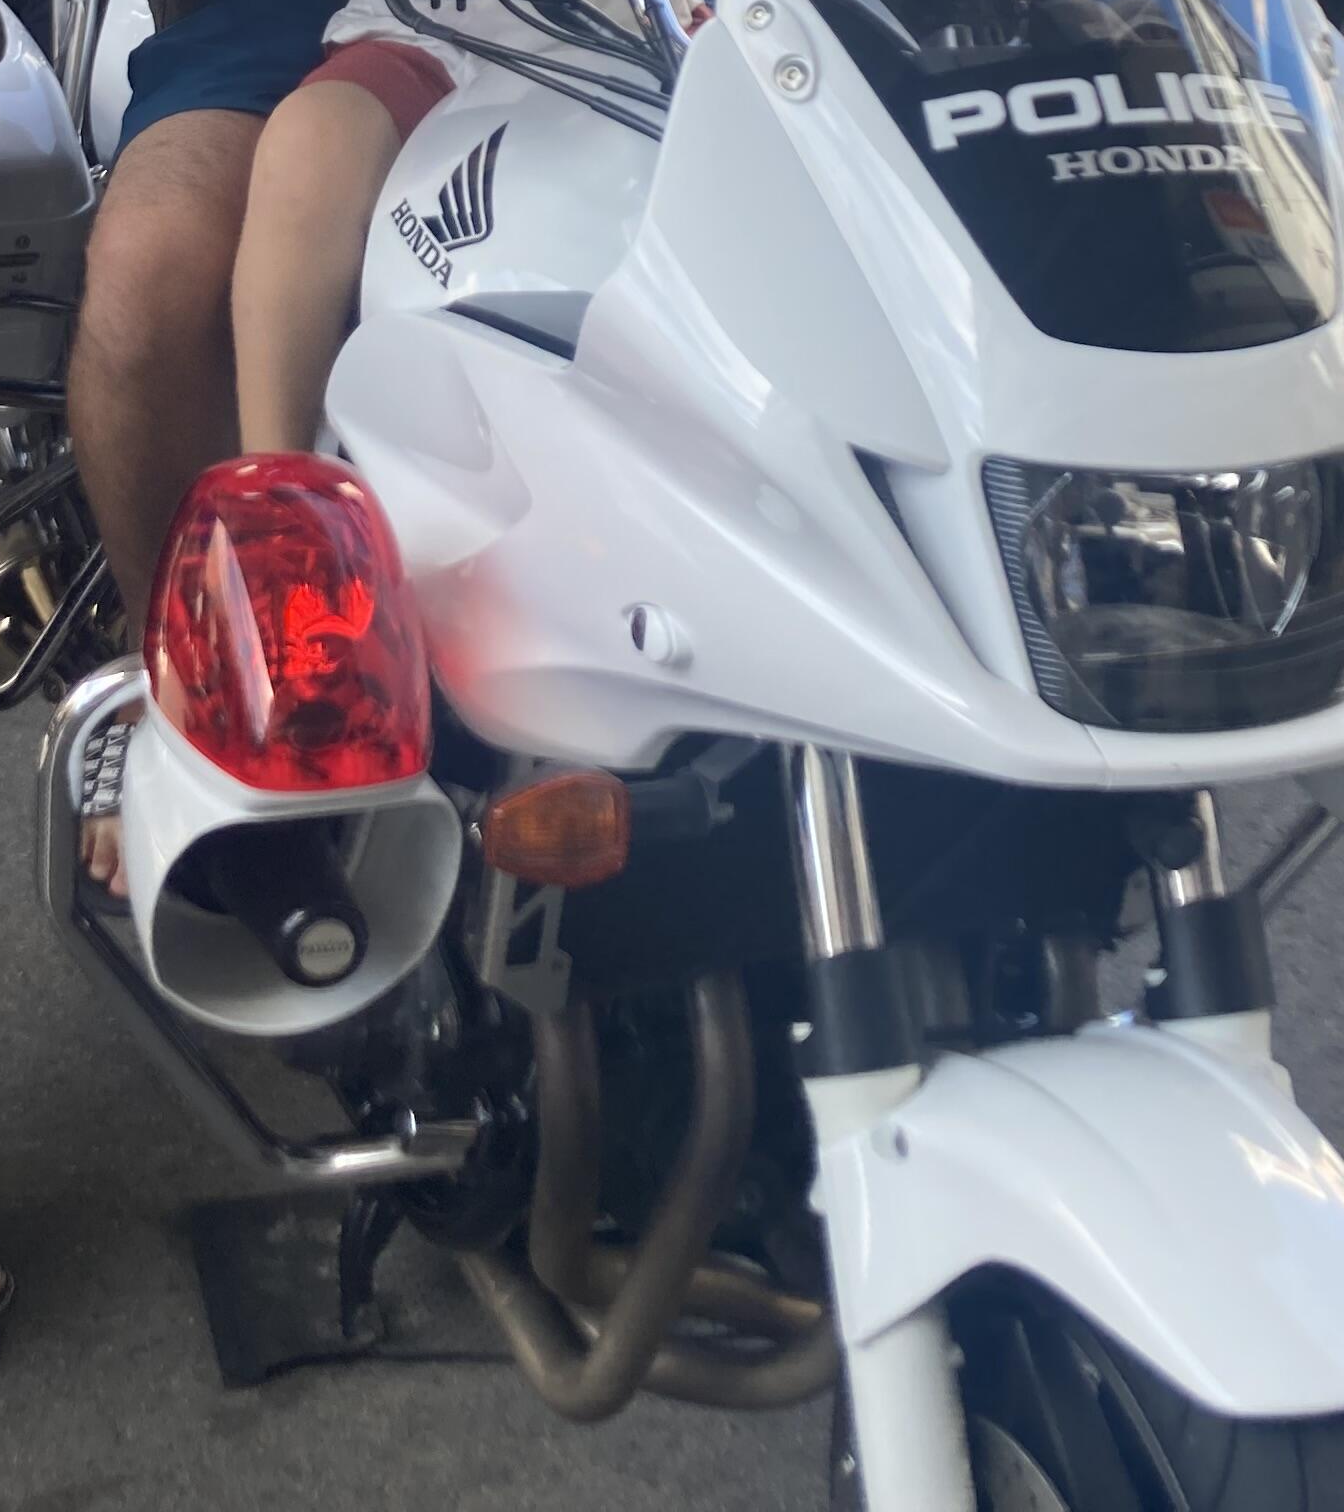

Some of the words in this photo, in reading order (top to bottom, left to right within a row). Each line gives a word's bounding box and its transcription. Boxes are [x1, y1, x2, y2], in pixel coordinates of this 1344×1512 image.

[922, 72, 1306, 152] POLICE
[1047, 144, 1264, 182] HONDA
[391, 197, 454, 290] HONDA
